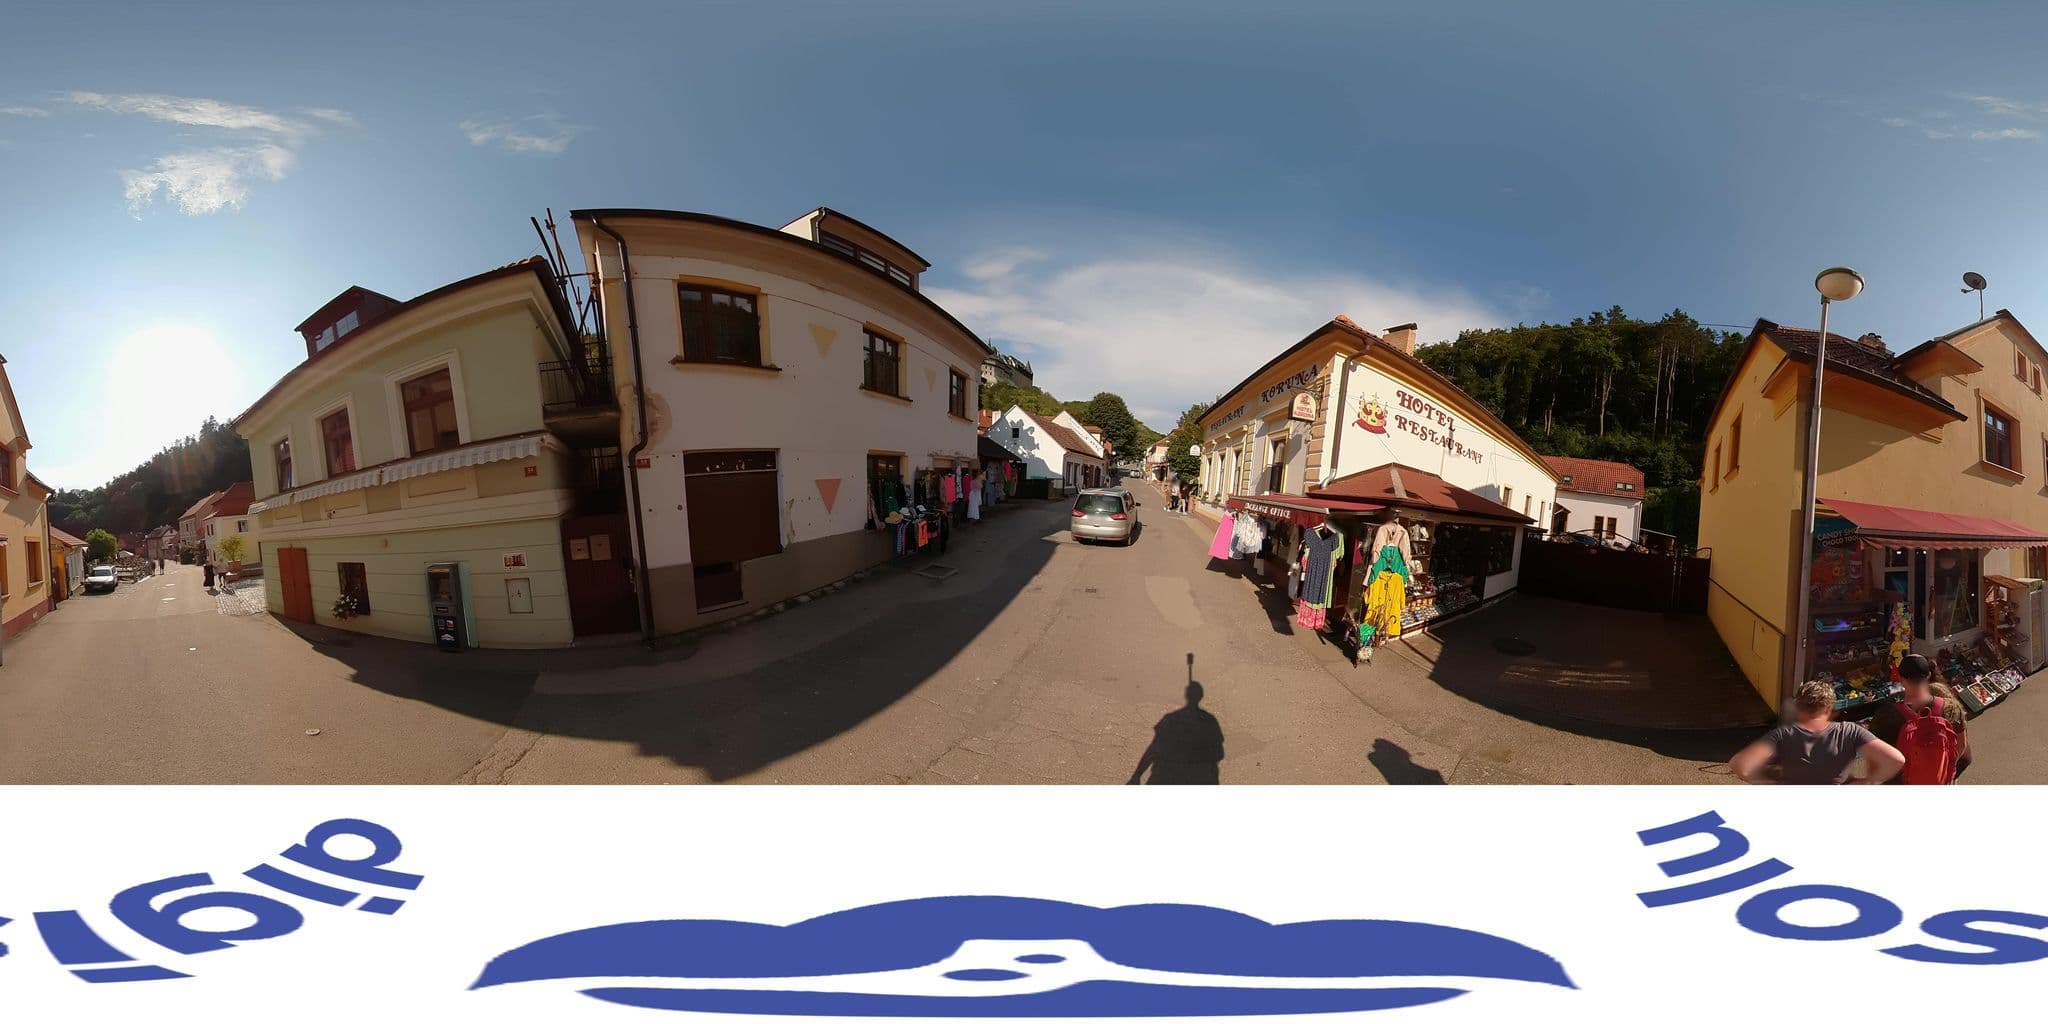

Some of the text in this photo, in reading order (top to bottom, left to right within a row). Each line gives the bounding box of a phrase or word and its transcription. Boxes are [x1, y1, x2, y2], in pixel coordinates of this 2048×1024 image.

[1261, 364, 1318, 403] KORUNA
[1396, 390, 1455, 432] HOTEL
[1395, 414, 1483, 464] RESTAURANT
[1817, 530, 1842, 541] CANDY
